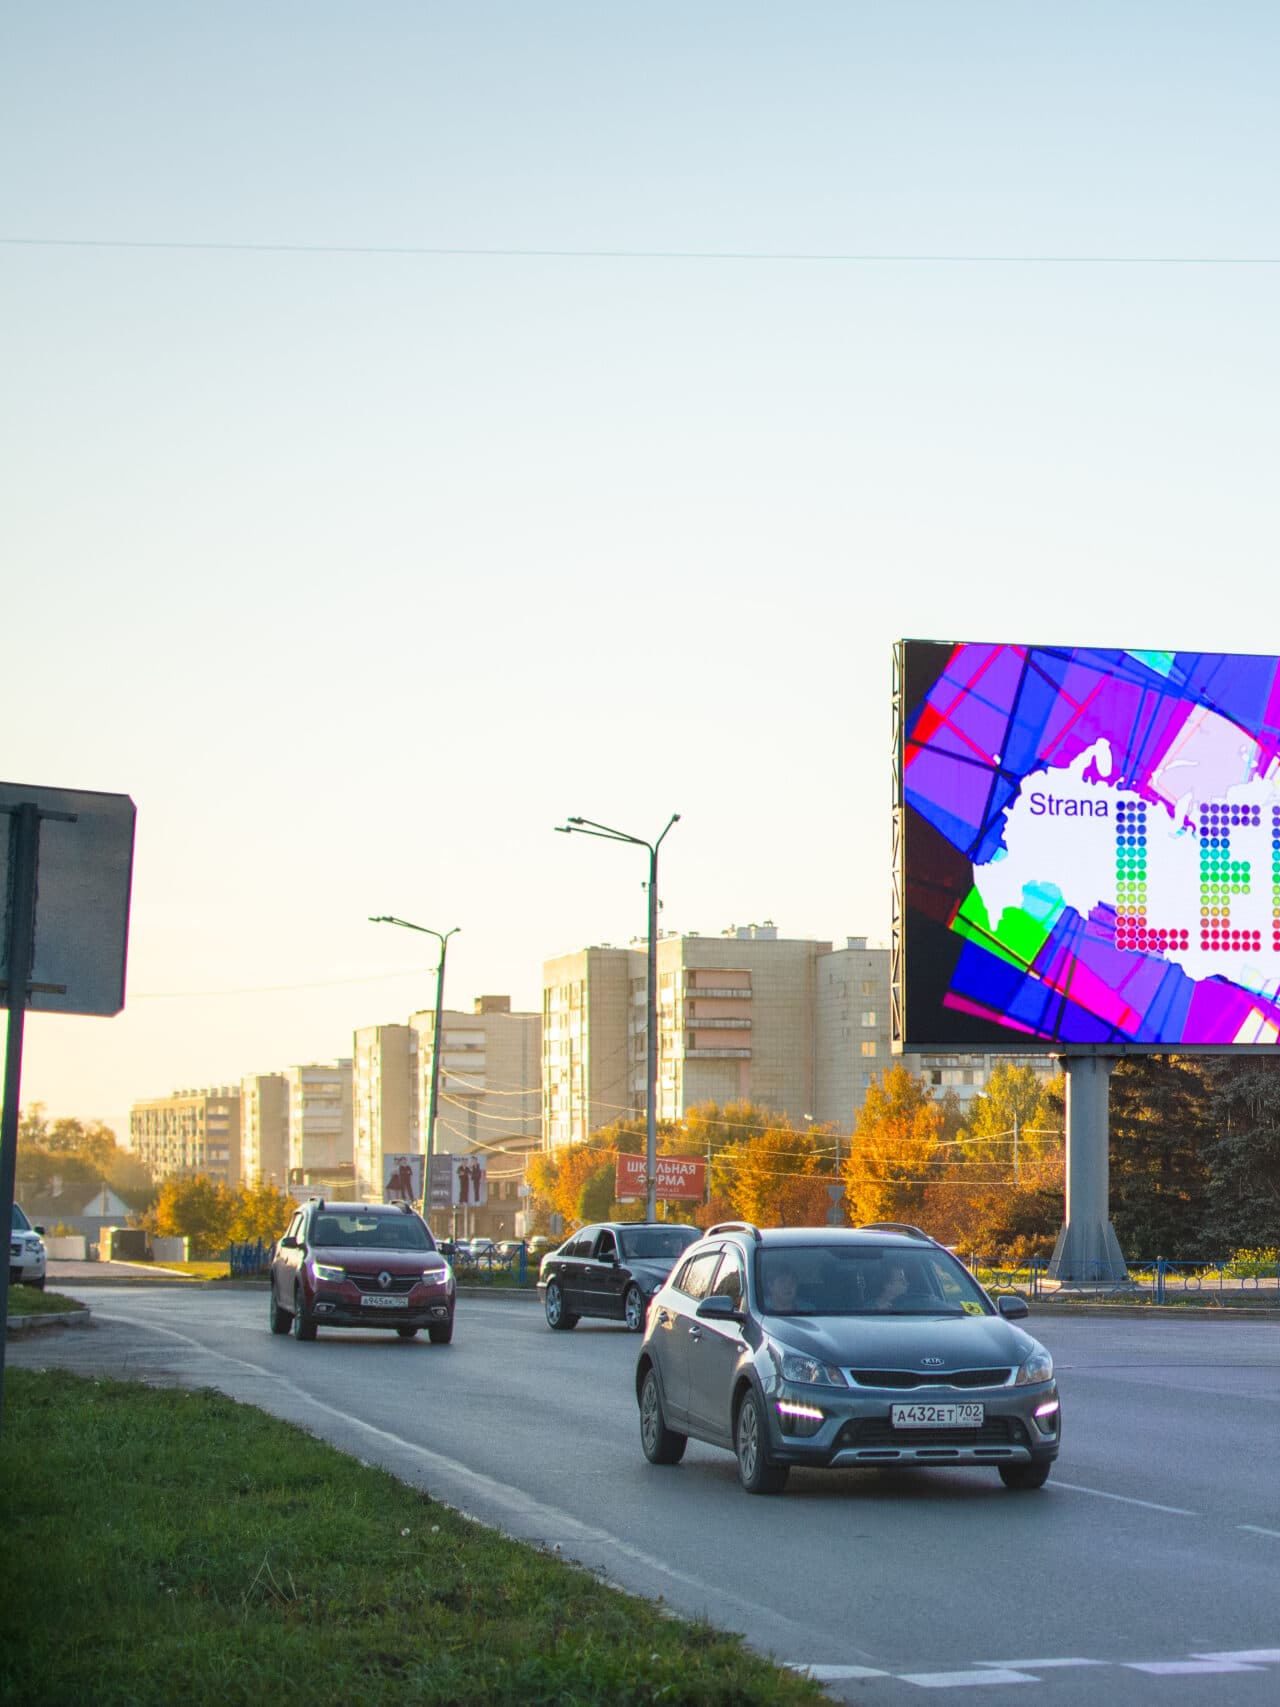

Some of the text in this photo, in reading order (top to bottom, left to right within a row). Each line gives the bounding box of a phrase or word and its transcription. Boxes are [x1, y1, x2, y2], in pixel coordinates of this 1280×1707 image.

[1029, 793, 1109, 817] Strana
[627, 1161, 696, 1175] ШКЛЬНАЯ
[637, 1174, 685, 1186] ФРМА
